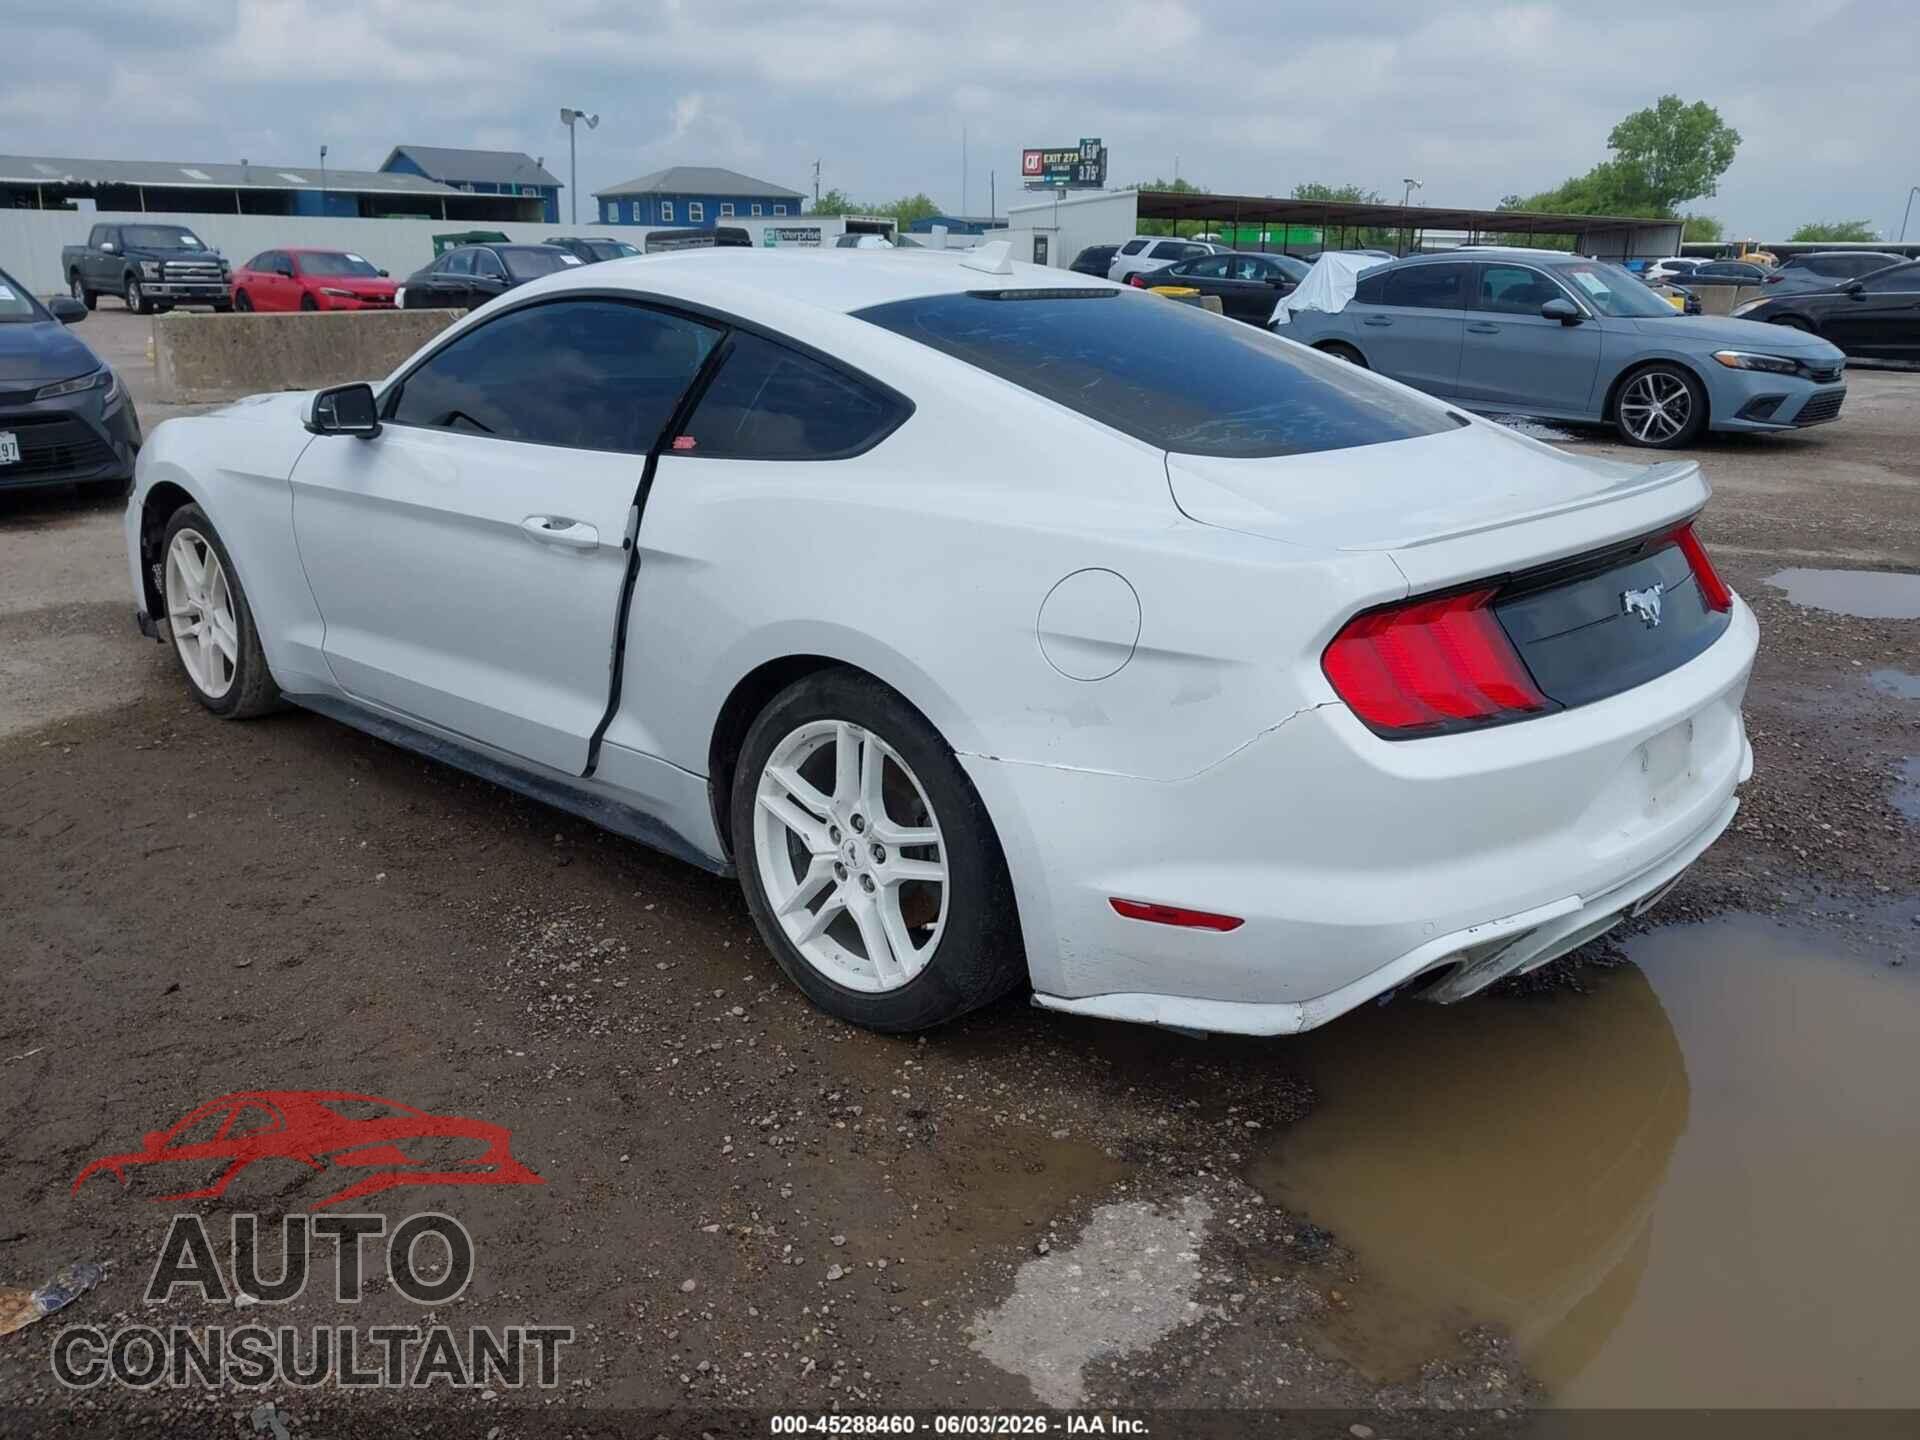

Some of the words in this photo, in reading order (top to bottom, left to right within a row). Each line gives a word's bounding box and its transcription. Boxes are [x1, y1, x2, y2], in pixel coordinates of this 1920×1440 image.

[1026, 155, 1039, 170] QT
[1044, 154, 1062, 163] EXIT
[1063, 153, 1079, 162] 273
[776, 229, 820, 241] Enterprise
[0, 442, 15, 458] 97
